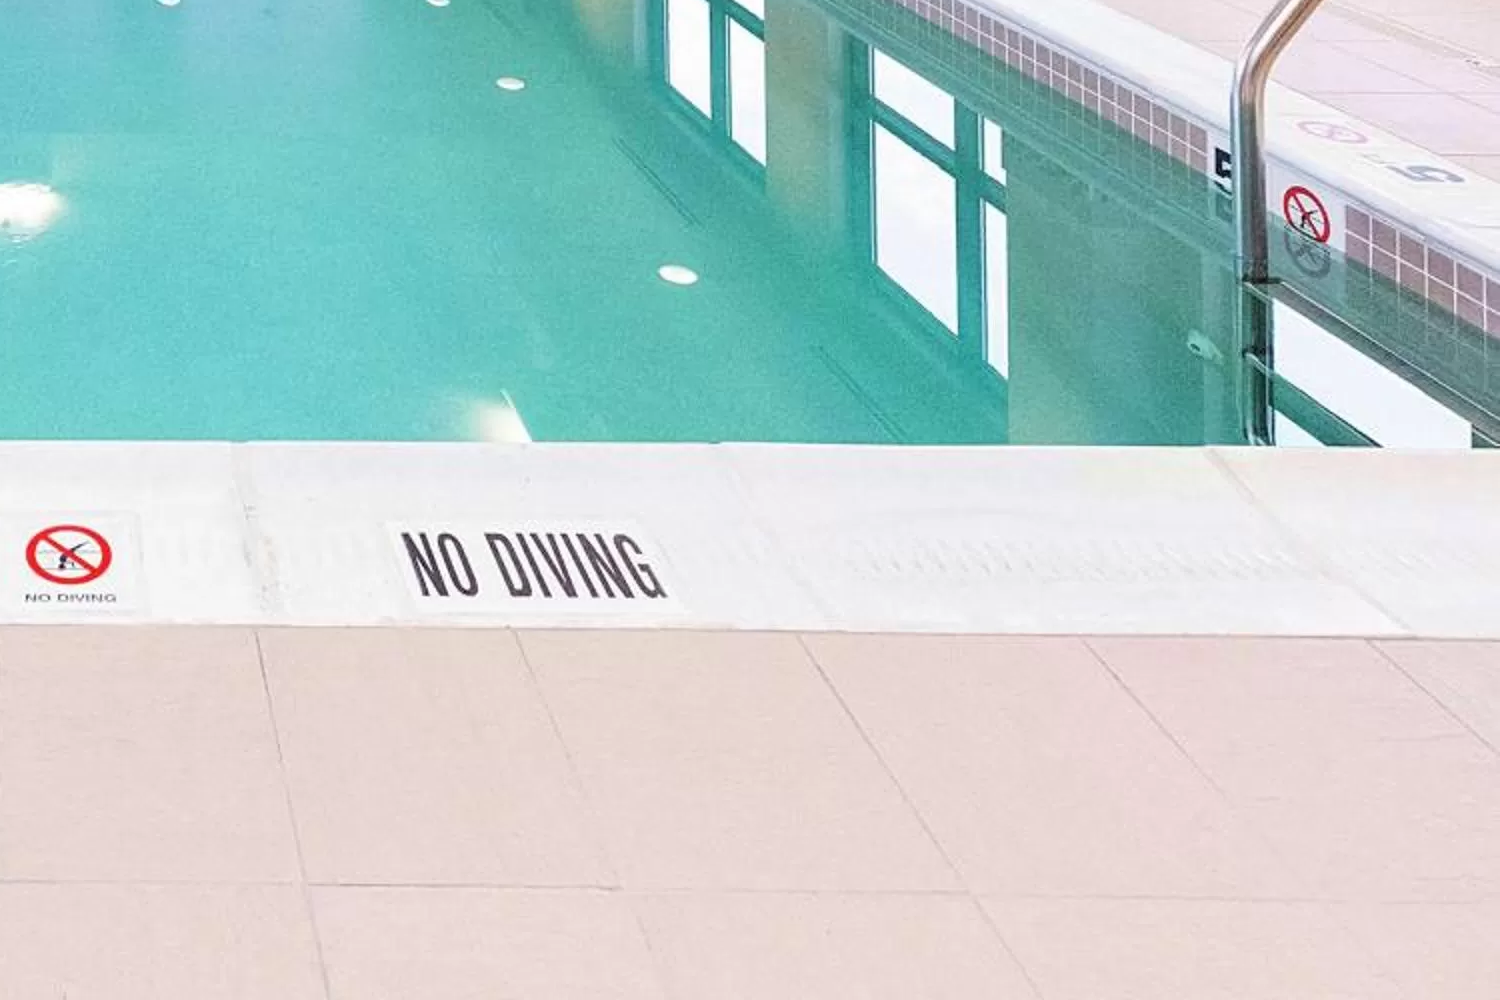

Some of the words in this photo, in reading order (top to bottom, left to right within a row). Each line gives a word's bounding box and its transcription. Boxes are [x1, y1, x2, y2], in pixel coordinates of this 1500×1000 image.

[401, 532, 479, 597] NO
[484, 532, 669, 599] DIVING
[24, 592, 52, 603] NO
[57, 592, 117, 603] DIVING
